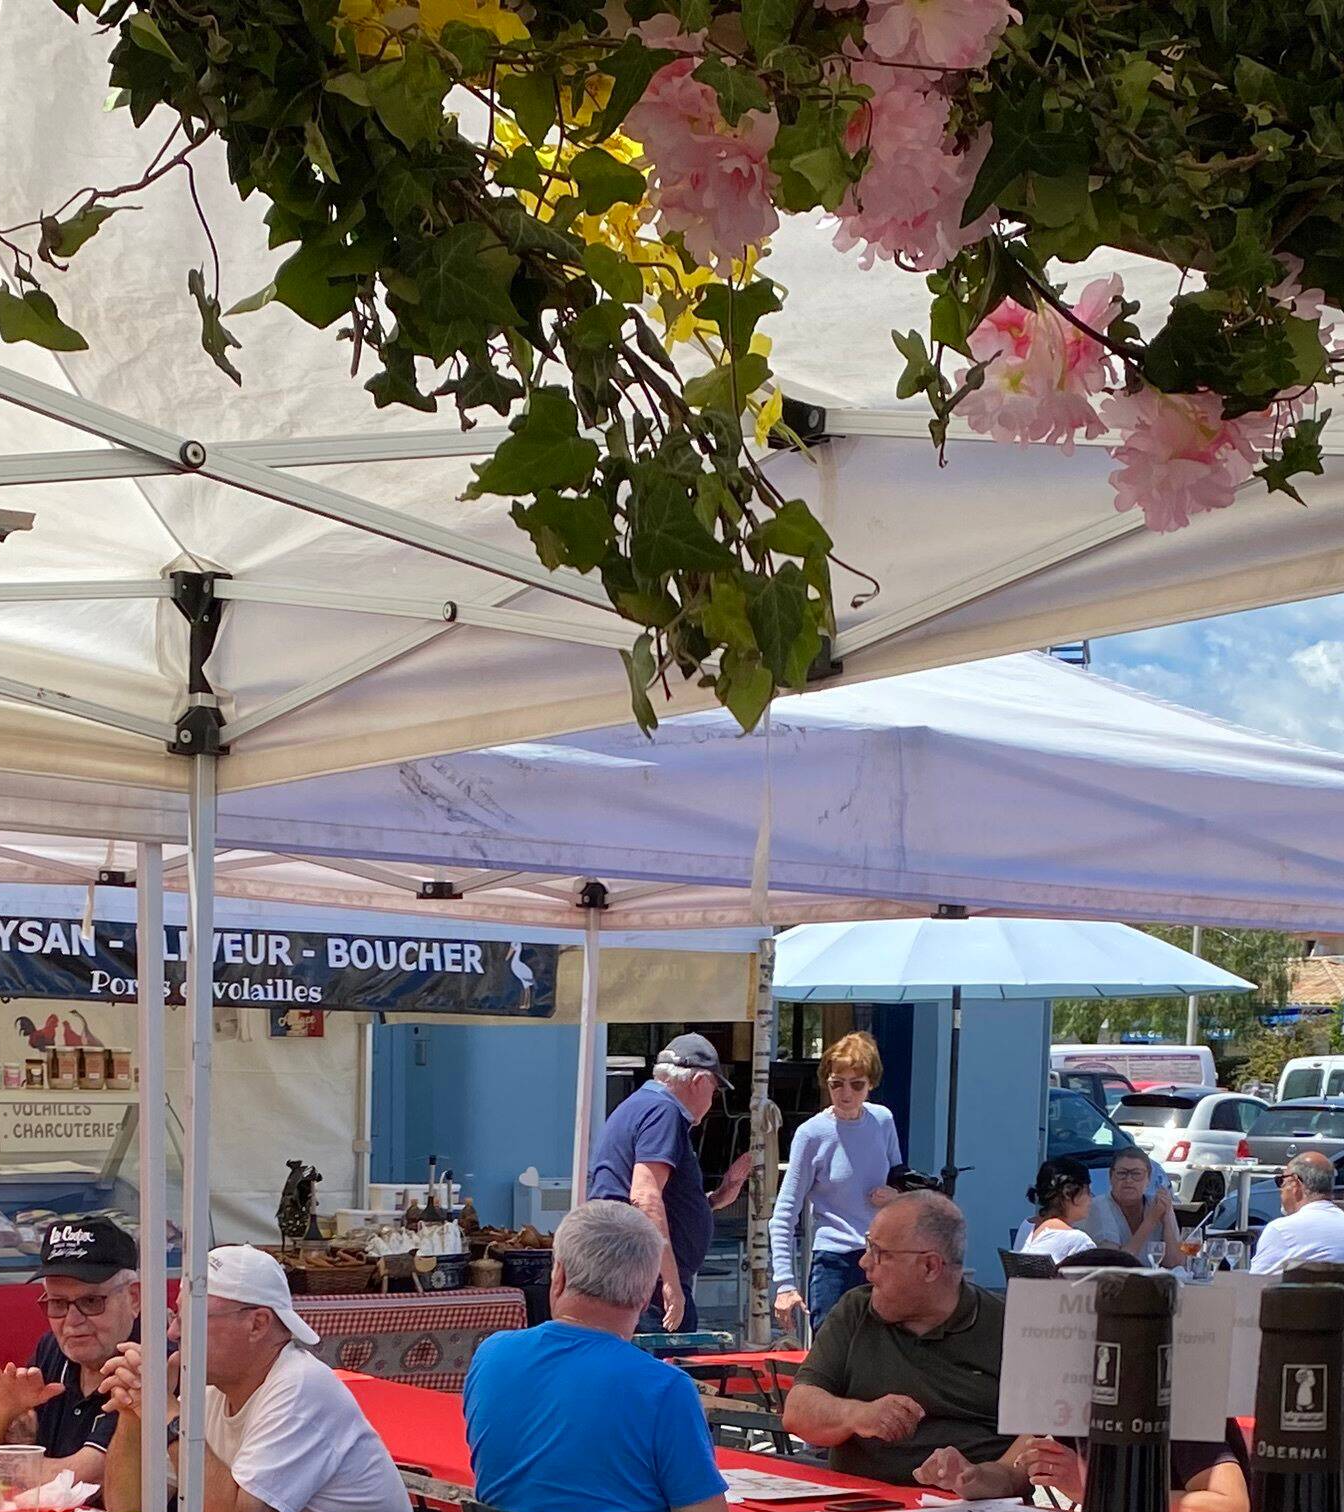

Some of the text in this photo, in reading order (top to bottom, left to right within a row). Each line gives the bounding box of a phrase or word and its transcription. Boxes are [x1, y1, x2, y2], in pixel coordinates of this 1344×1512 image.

[327, 937, 485, 974] BOUCHER
[213, 977, 322, 1002] volailles
[1258, 1441, 1327, 1460] OBERNAI
